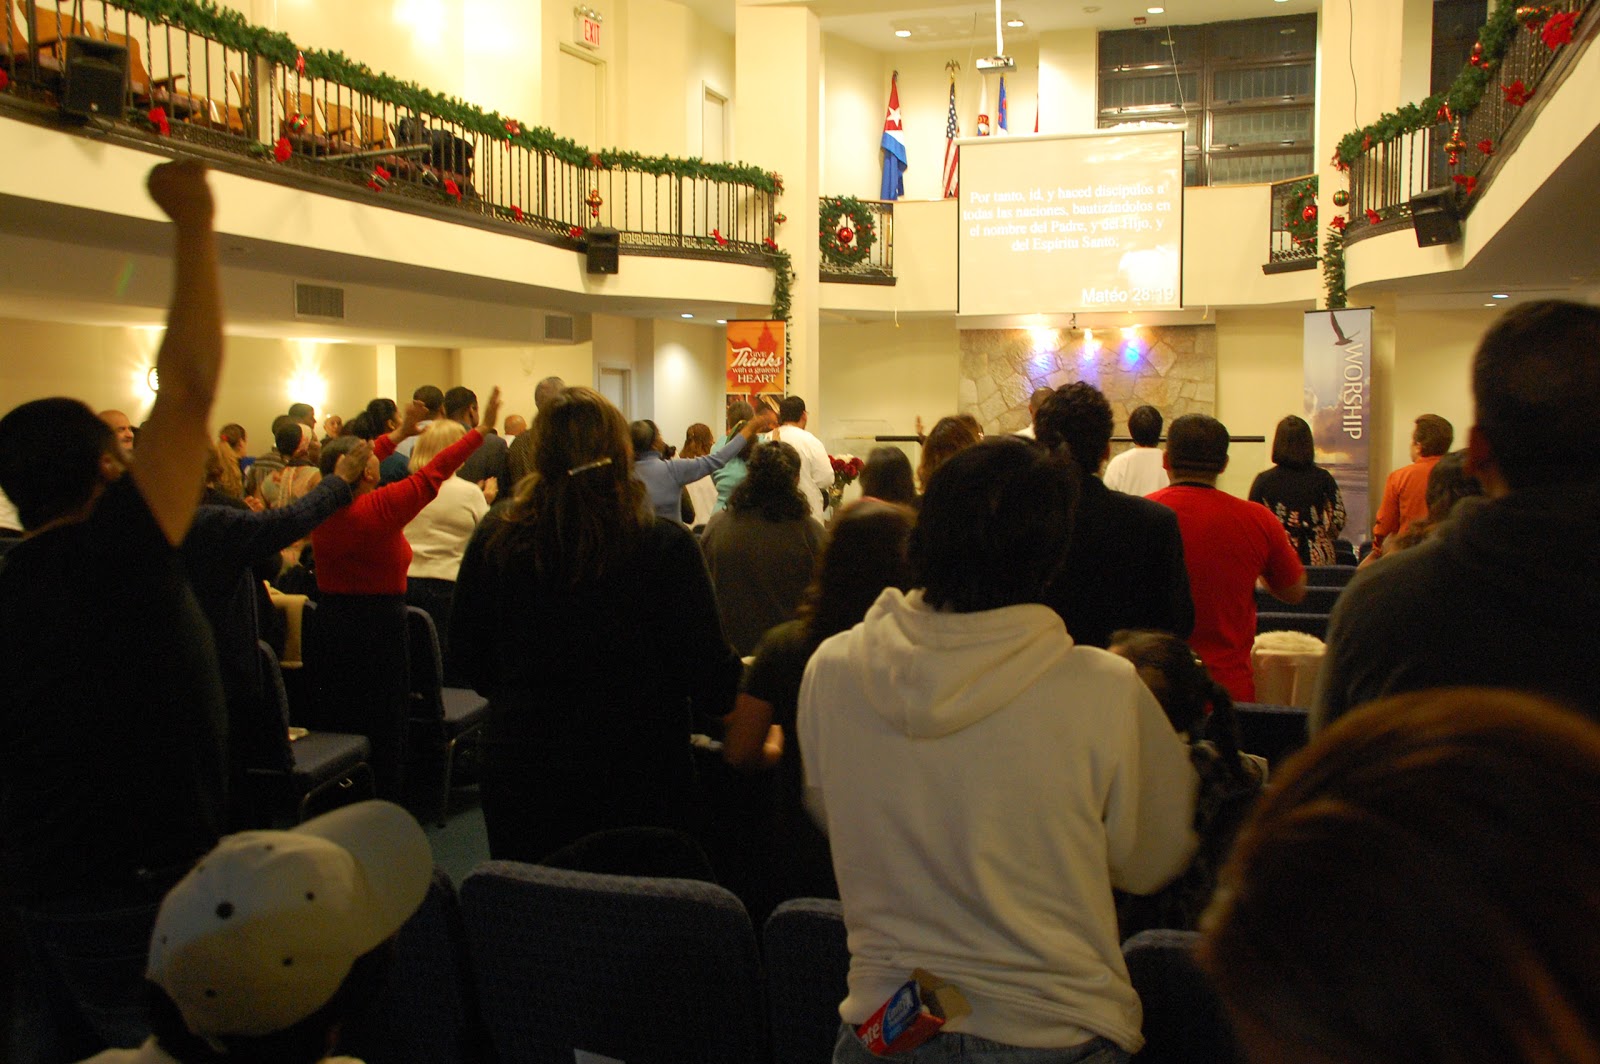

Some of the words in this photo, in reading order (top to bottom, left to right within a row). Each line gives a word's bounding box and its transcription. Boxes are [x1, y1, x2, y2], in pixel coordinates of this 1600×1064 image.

[585, 19, 600, 46] EXIT
[970, 191, 990, 203] Por
[994, 191, 1025, 203] tanto,
[1029, 187, 1044, 201] id,
[1047, 190, 1055, 203] y
[1058, 185, 1091, 199] haced
[963, 207, 993, 221] todas
[997, 206, 1013, 219] las
[1016, 205, 1069, 219] naciones,
[1156, 202, 1171, 212] en
[970, 224, 980, 237] el
[983, 221, 1027, 236] nombre
[1029, 221, 1047, 234] del
[1051, 219, 1087, 233] Padre,
[1090, 221, 1098, 234] y
[1101, 215, 1119, 230] del
[1122, 215, 1152, 232] Hijo,
[1156, 218, 1164, 231] y
[1012, 238, 1029, 251] del
[731, 347, 781, 367] Thanks
[738, 375, 776, 383] HEART
[1343, 343, 1363, 440] WORSHIP
